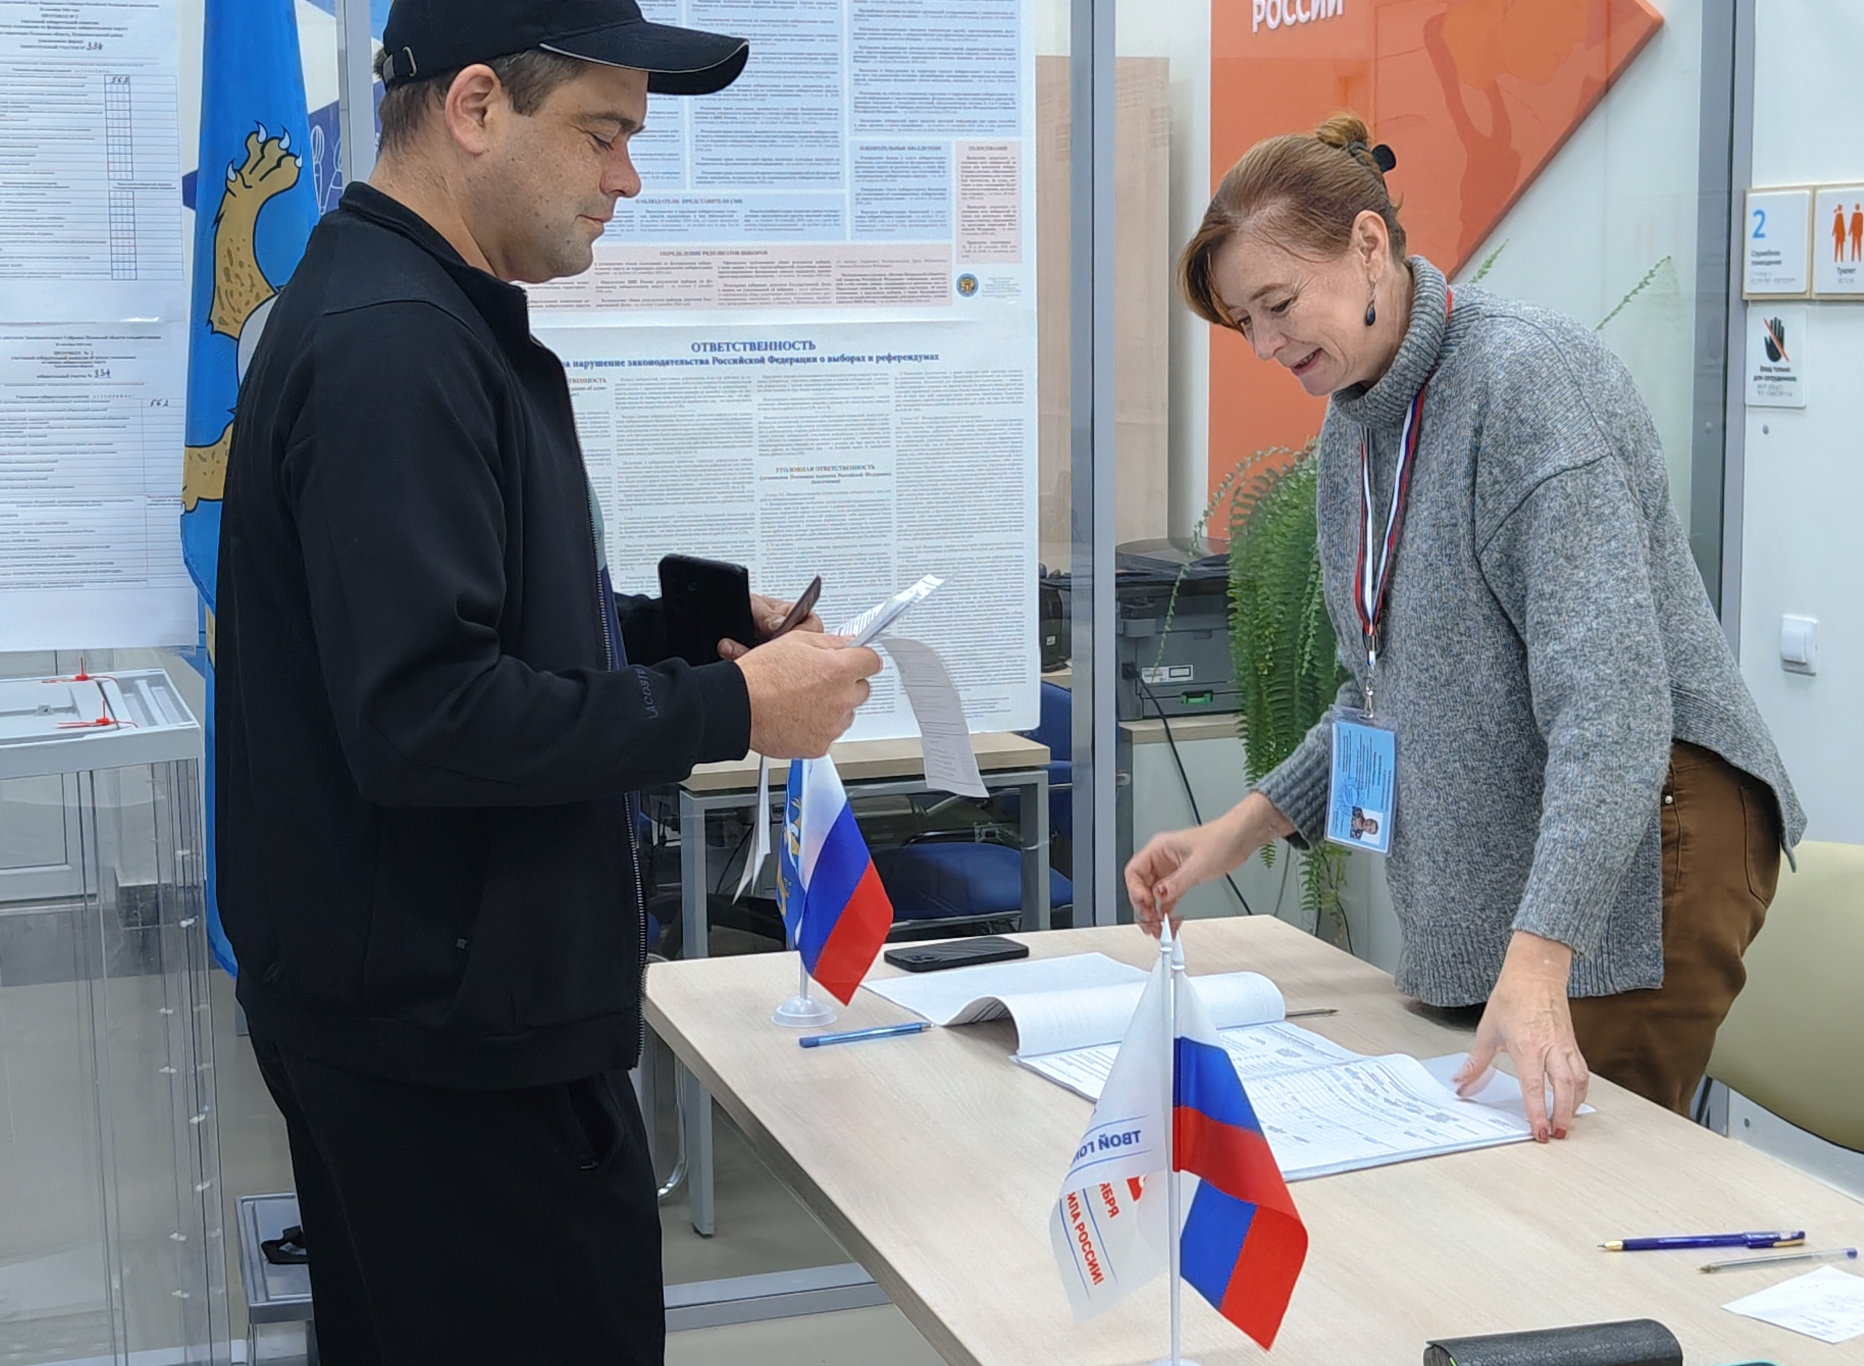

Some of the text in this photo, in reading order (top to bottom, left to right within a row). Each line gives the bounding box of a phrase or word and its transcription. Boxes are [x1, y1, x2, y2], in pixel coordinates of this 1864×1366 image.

[1752, 209, 1766, 239] 2
[691, 340, 816, 353] ОТВЕТСТВЕННОСТЬ
[573, 359, 626, 369] нарушение
[627, 358, 710, 368] законодательства
[711, 355, 765, 366] Российской
[767, 355, 818, 366] Федерации
[827, 354, 866, 365] выборах
[875, 353, 939, 365] референдумах
[1074, 1221, 1105, 1286] РОССИИ!
